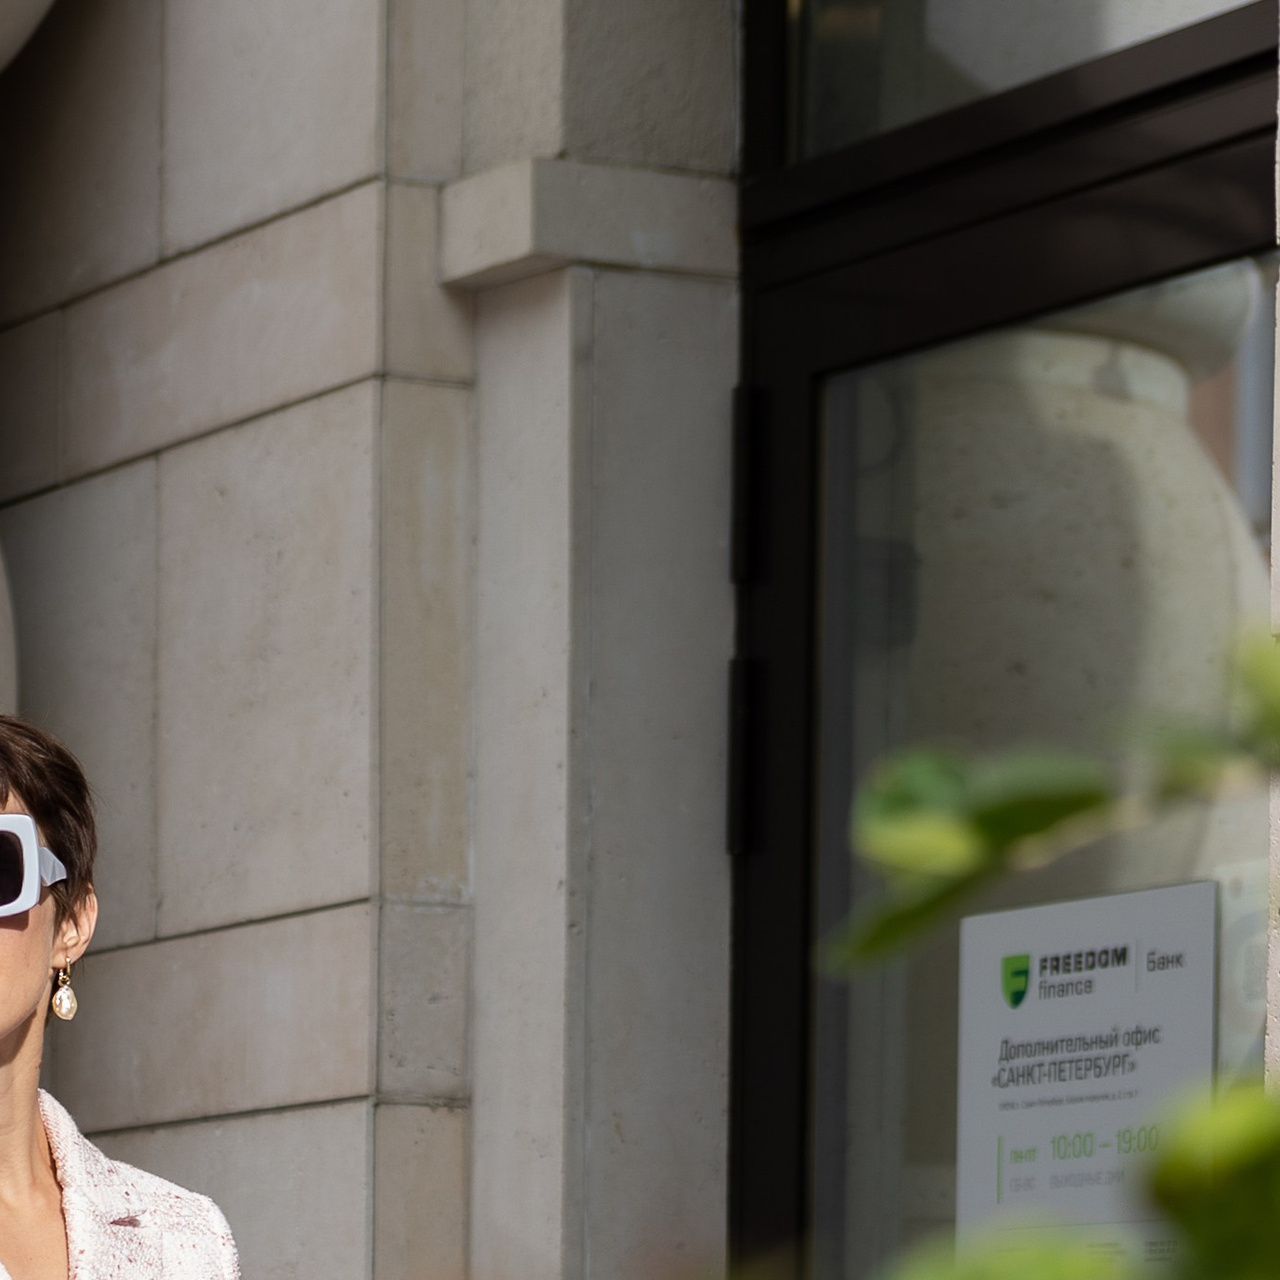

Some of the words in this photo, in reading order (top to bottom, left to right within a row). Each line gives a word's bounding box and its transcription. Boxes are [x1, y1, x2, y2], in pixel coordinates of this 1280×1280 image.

[1039, 946, 1128, 977] FREEDOM
[1146, 950, 1184, 973] Банк
[1038, 978, 1094, 1000] finance
[998, 1026, 1118, 1063] Дополнительный
[1122, 1025, 1160, 1050] офис
[991, 1054, 1136, 1089] «САНКТ-ПЕТЕРБУРГ»
[1051, 1133, 1094, 1160] 10:00
[1116, 1126, 1158, 1154] 19:00
